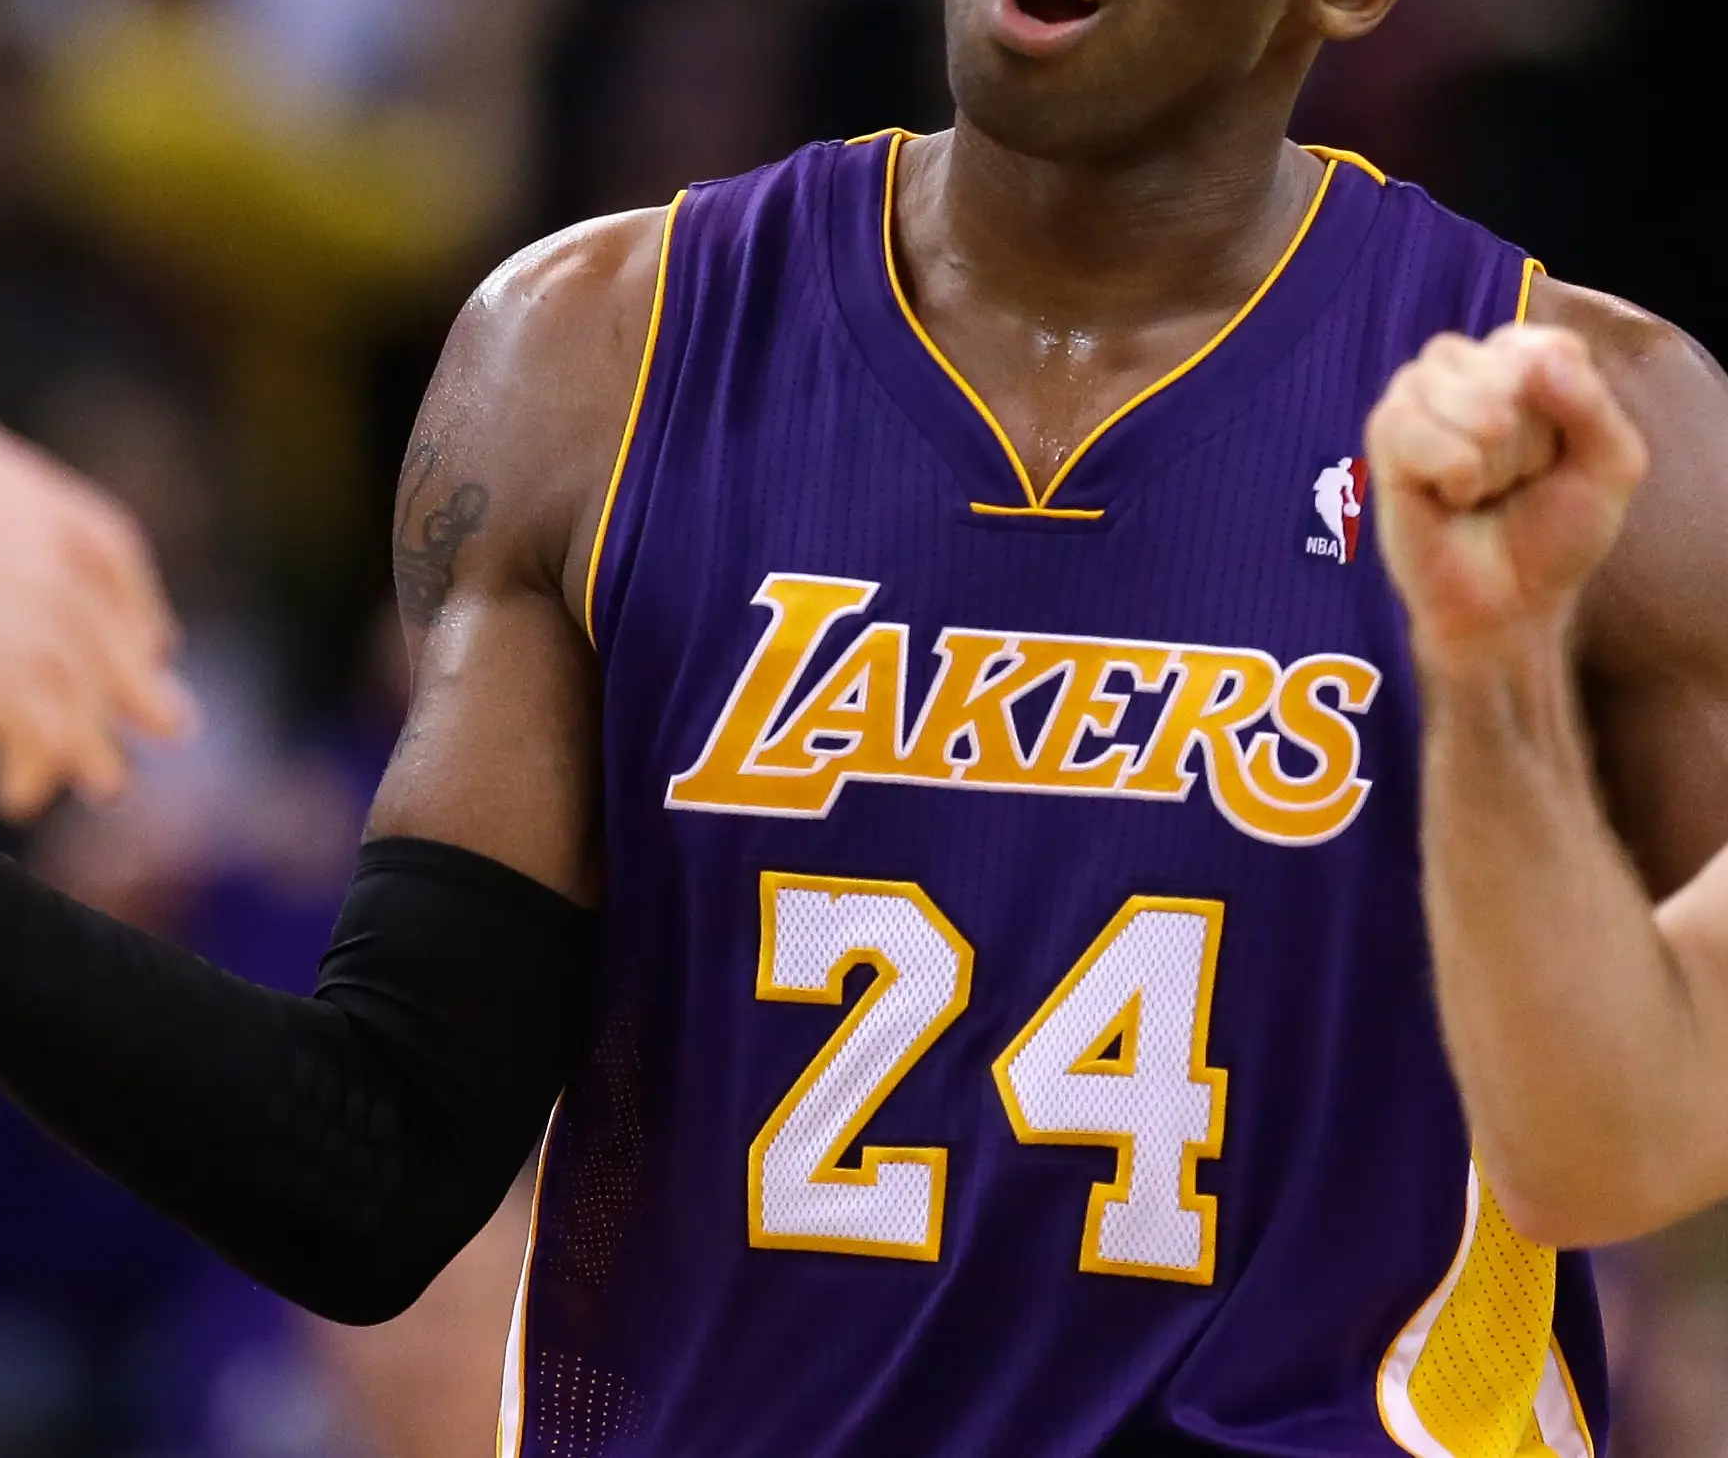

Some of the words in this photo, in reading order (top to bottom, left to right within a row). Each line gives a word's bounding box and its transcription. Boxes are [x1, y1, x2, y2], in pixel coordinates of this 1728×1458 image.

[1305, 536, 1339, 558] NBA
[664, 572, 1382, 847] LAKERS
[748, 870, 1228, 1286] 24
